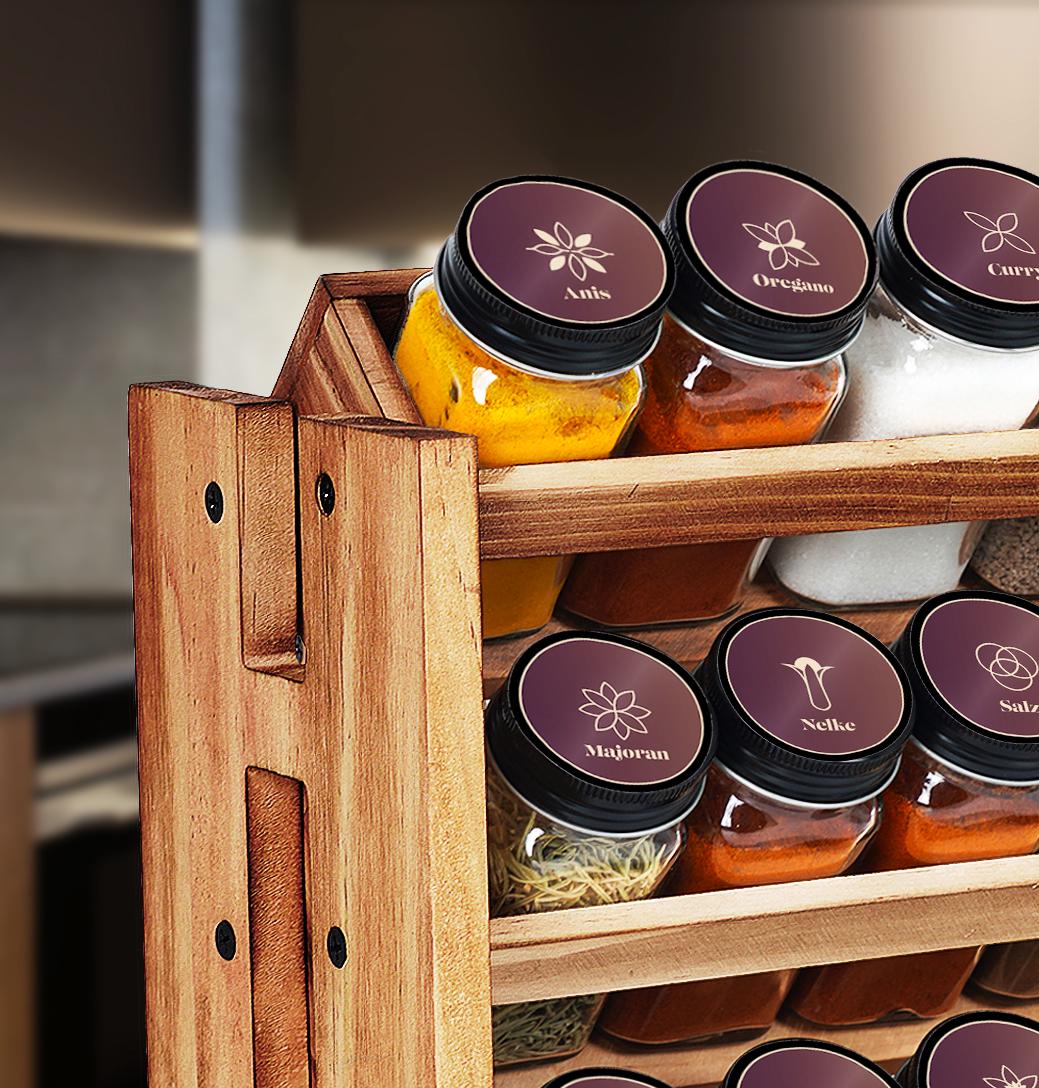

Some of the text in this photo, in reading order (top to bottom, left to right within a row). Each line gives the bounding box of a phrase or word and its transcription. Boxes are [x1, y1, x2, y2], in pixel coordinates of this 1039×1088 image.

[752, 273, 834, 294] Oregano
[564, 285, 613, 300] Anis
[800, 718, 857, 733] Nelke
[584, 743, 670, 762] Majoran
